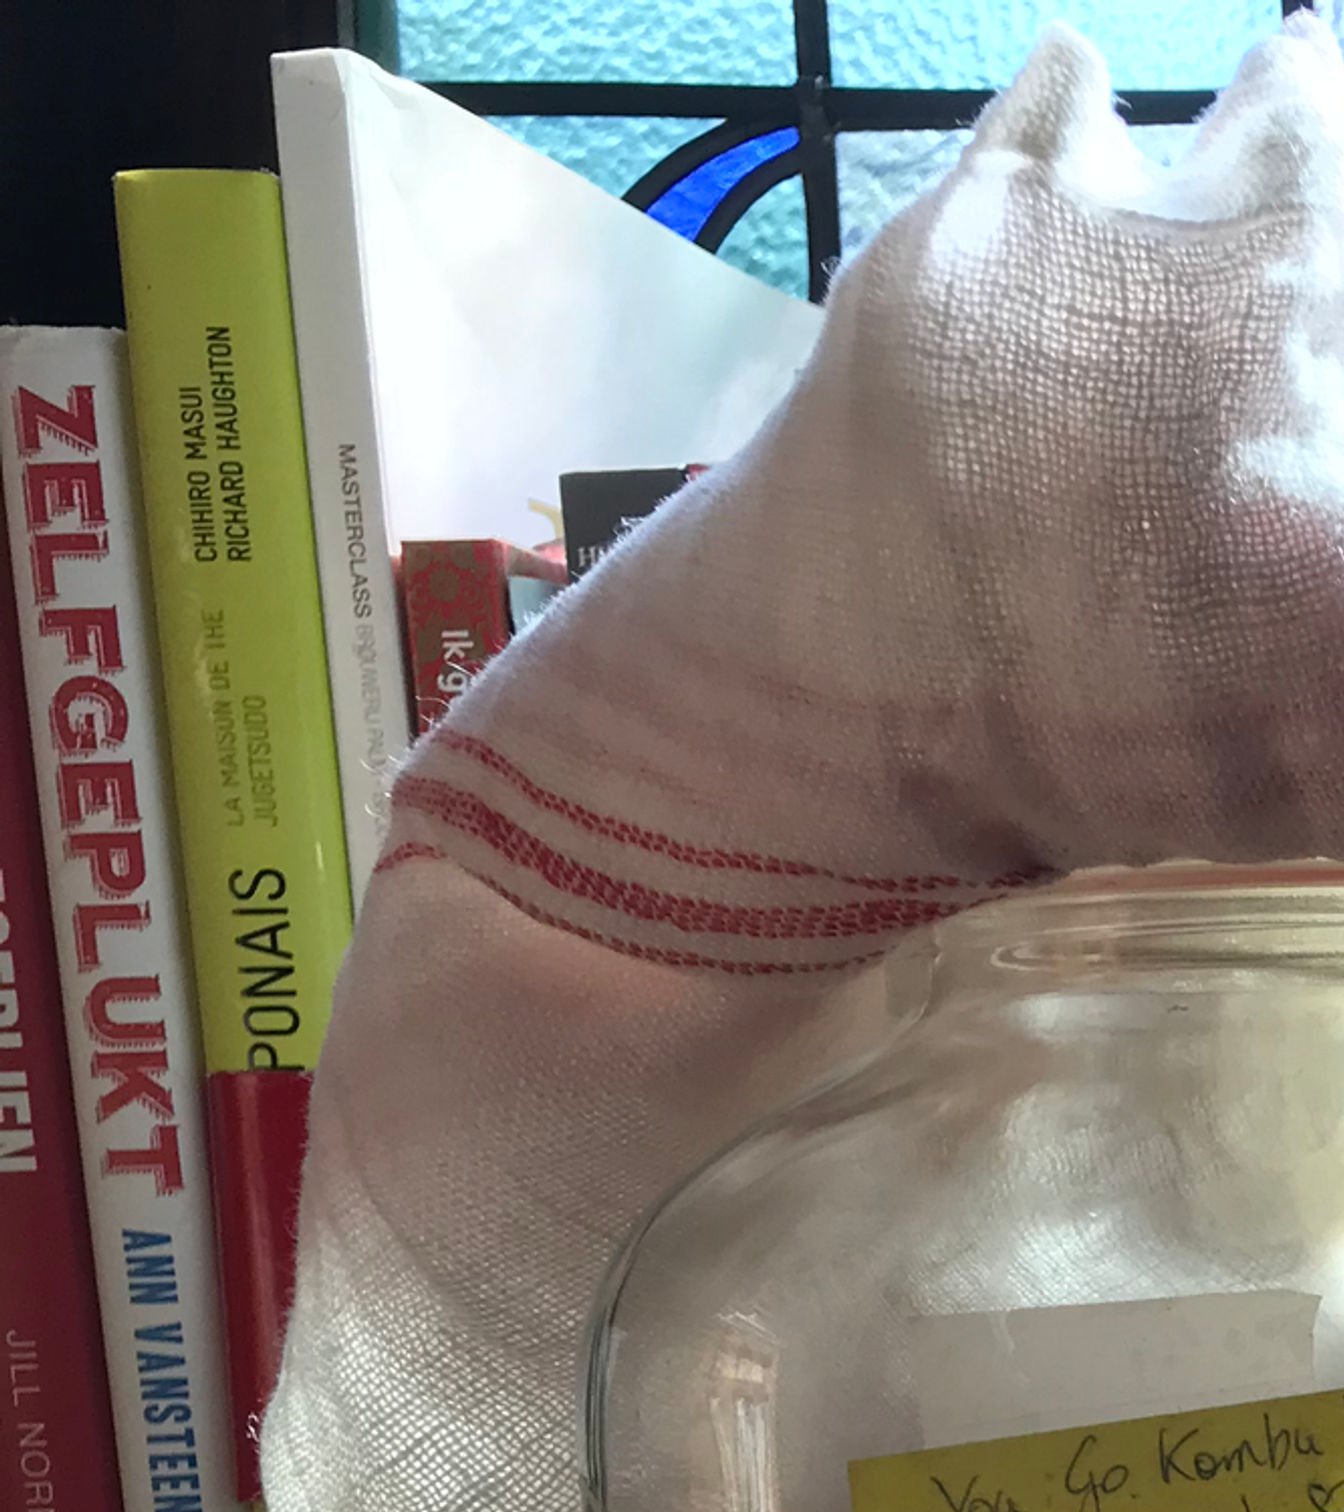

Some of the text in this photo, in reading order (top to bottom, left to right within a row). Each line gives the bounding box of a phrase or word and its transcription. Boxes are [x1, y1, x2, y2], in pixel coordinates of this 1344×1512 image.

[179, 386, 217, 564] CHIHIRO MASUI
[206, 325, 252, 563] RICHARD HAUGHTON
[337, 442, 373, 619] MASTERCLASS
[13, 383, 184, 1197] ZELFGEPLUKT
[248, 694, 280, 829] JUGETSUDO
[121, 1228, 181, 1308] ANN
[4, 1329, 41, 1408] JILL
